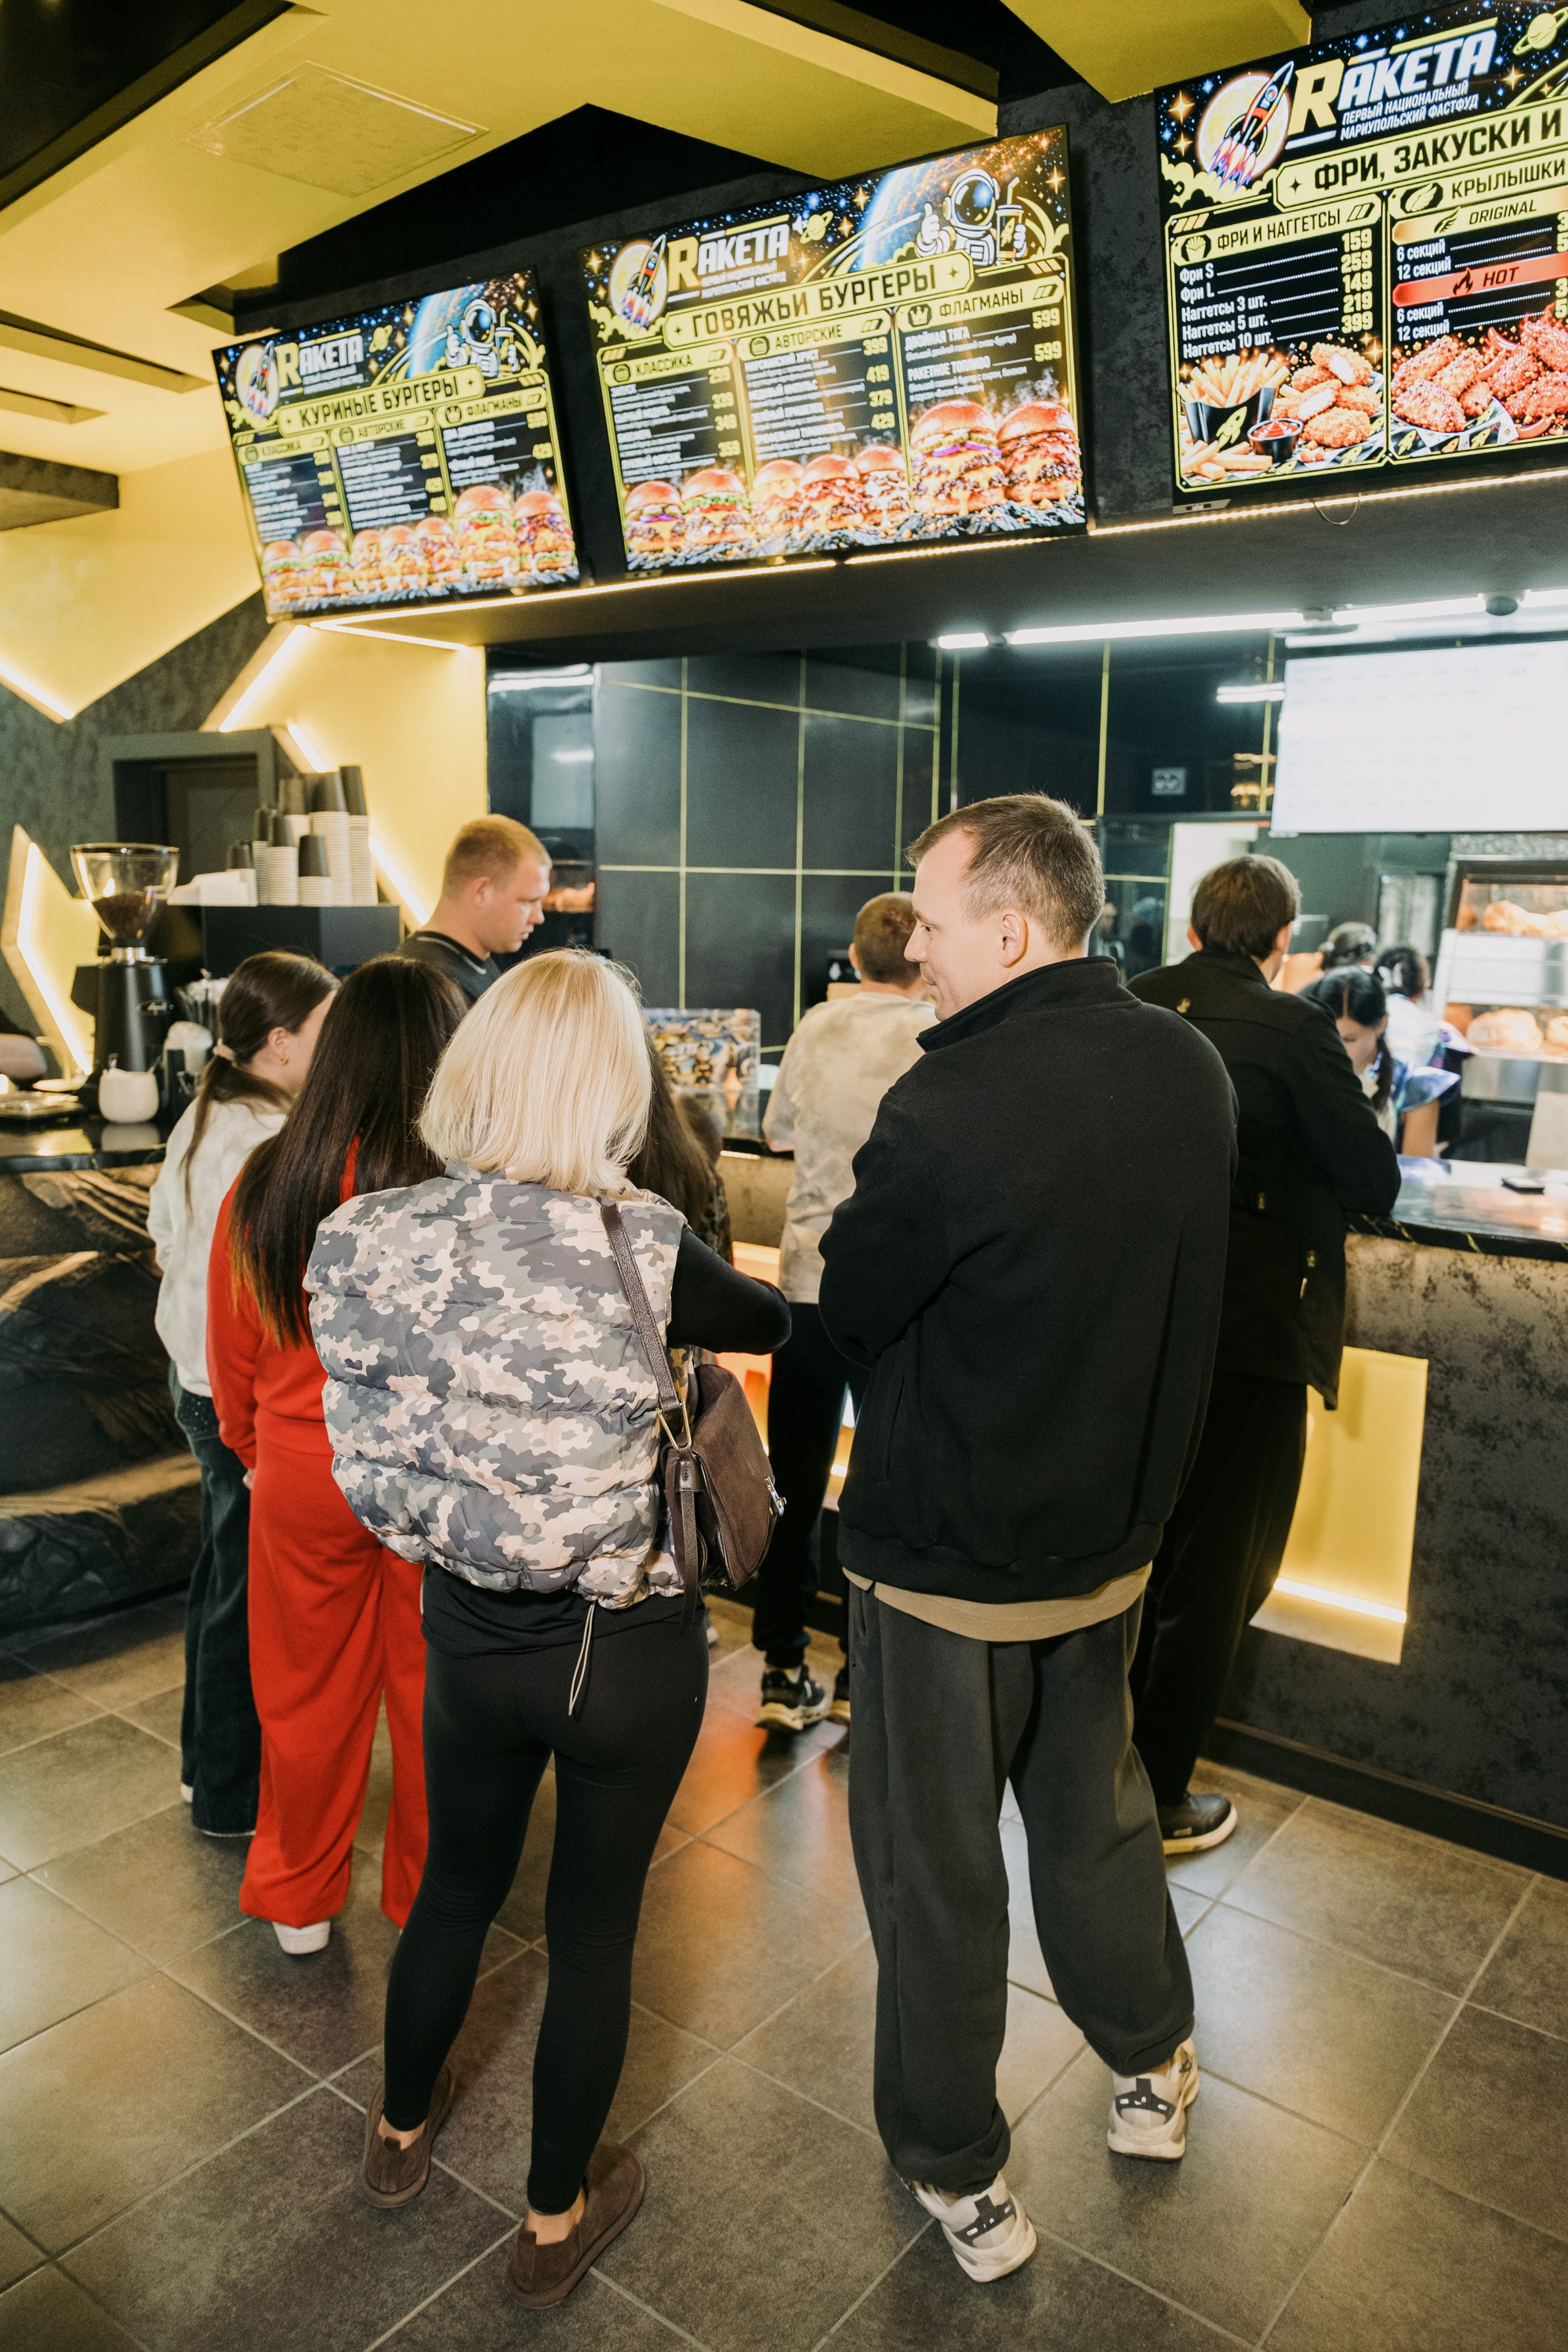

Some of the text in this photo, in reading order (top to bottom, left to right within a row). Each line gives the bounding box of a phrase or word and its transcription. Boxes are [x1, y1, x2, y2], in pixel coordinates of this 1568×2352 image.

[1341, 79, 1469, 126] ПЕРВЫЙ НАЦИОНАЛЬНЫЙ
[1340, 93, 1479, 141] МАРИУПОЛЬСКИЙ ФАСТФУД
[1315, 107, 1562, 191] ФРИ, ЗАКУСКИ И
[1452, 158, 1566, 199] КРЫЛЫШКИ
[1468, 199, 1537, 225] ORIGINAL
[1218, 209, 1341, 249] ФРИ И НАГГЕТСЫ
[1179, 228, 1373, 285] Фри S 159
[1396, 246, 1405, 263] 6
[1406, 238, 1446, 260] секций
[1180, 250, 1373, 304] Фри L 259
[1396, 263, 1411, 281] 12
[1413, 256, 1451, 278] секций
[1483, 266, 1520, 287] HOT
[692, 263, 937, 337] ГОВЯЖЬИ БУРГЕРЫ
[939, 288, 1024, 317] ФЛАГМАНЫ
[1181, 270, 1373, 323] Наггетсы 3 шт. 149
[1032, 308, 1061, 329] 599
[1181, 290, 1374, 341] Наггетсы 5 шт. 219
[1396, 307, 1405, 323] 6
[1406, 301, 1444, 321] секций
[775, 324, 844, 350] АВТОРСКИЕ
[1182, 310, 1374, 359] Наггетсы 10 шт. 399
[1396, 325, 1411, 342] 12
[1412, 319, 1450, 340] секций
[862, 336, 888, 357] 399
[1034, 341, 1063, 362] 599
[635, 353, 693, 376] КЛАССИКА
[866, 364, 891, 383] 419
[298, 394, 378, 428] КУРИНЫЕ
[383, 376, 459, 411] БУРГЕРЫ
[868, 388, 894, 408] 379
[871, 412, 896, 430] 429
